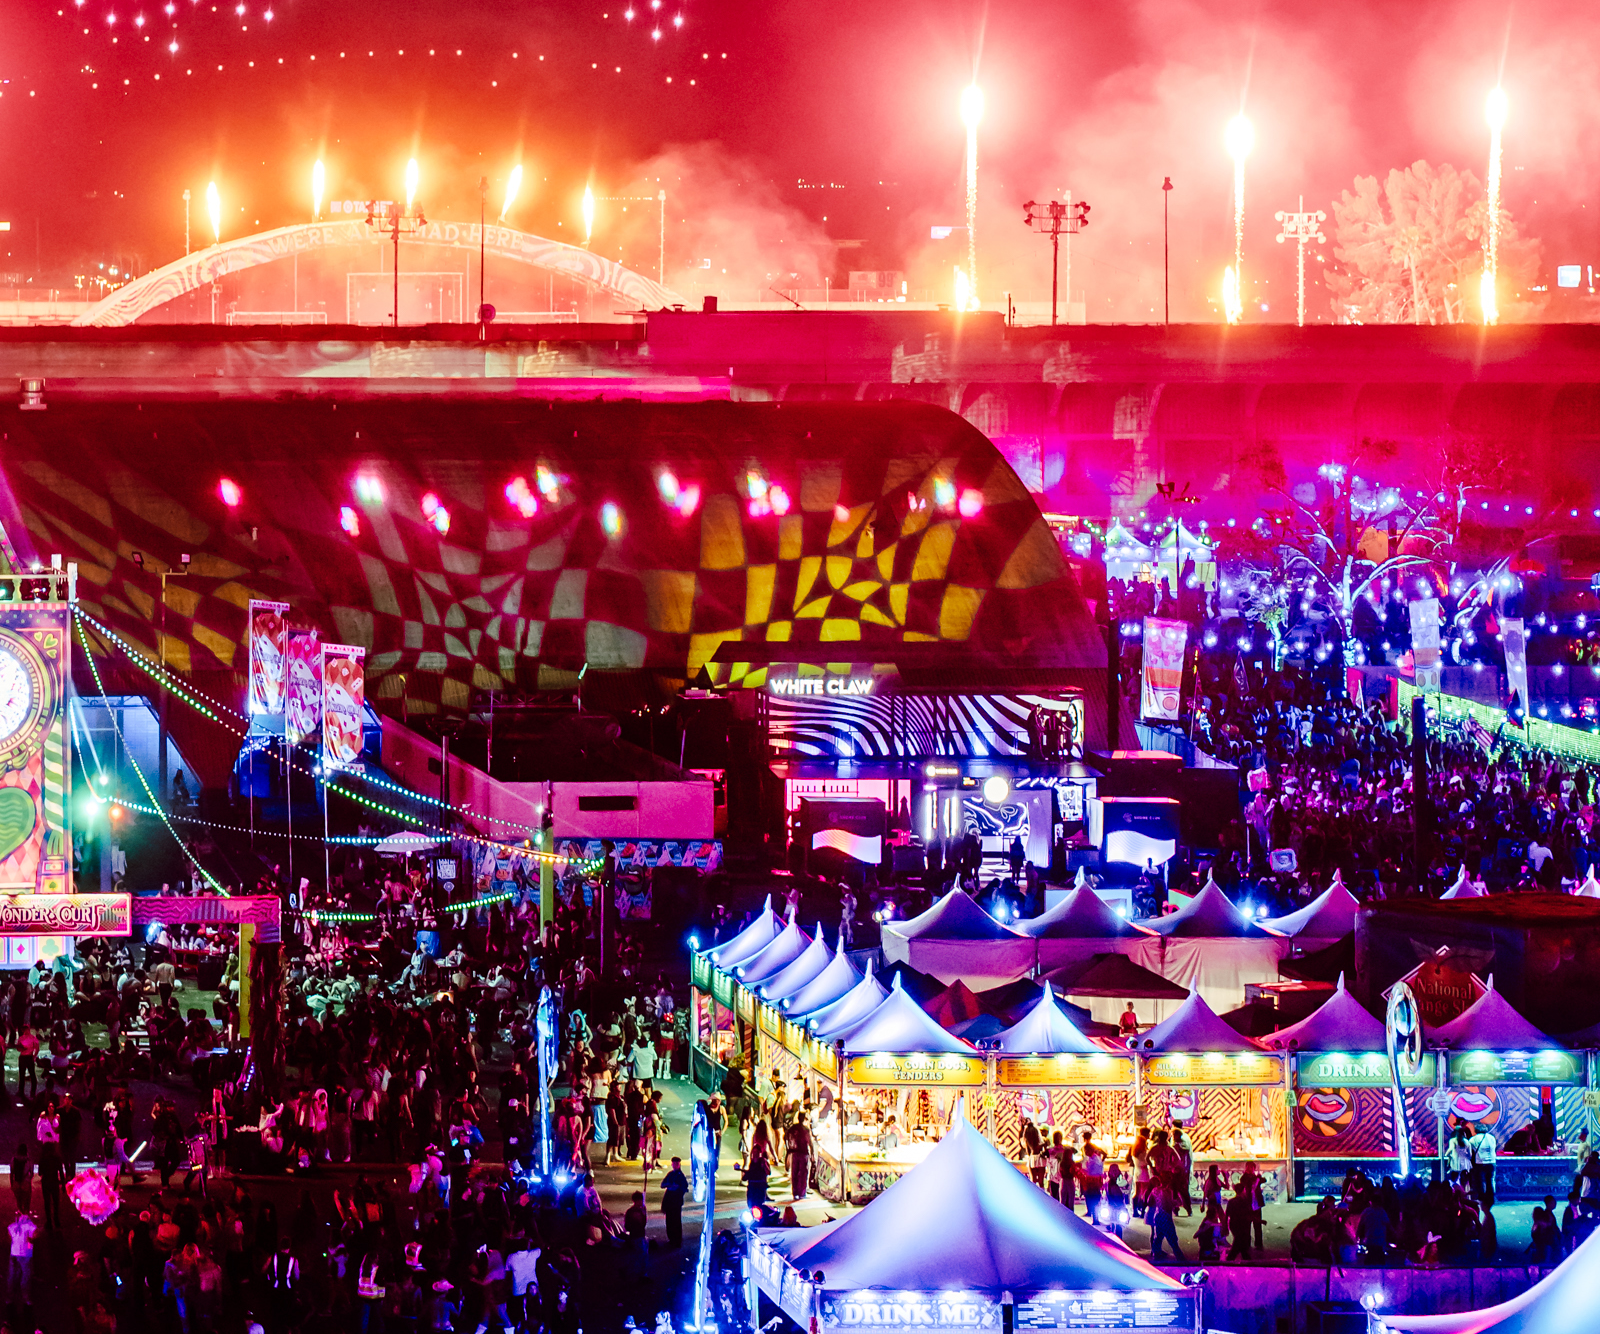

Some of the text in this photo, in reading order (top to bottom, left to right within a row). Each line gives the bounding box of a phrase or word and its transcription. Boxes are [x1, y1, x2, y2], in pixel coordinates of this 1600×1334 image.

[409, 223, 459, 240] MAD
[468, 227, 524, 251] HERE
[769, 678, 874, 695] WHITE CLAW
[1417, 977, 1472, 1000] National
[893, 1071, 944, 1081] TENDERS
[1318, 1063, 1384, 1077] DRINK
[842, 1303, 933, 1326] DRINK
[937, 1303, 980, 1325] ME
